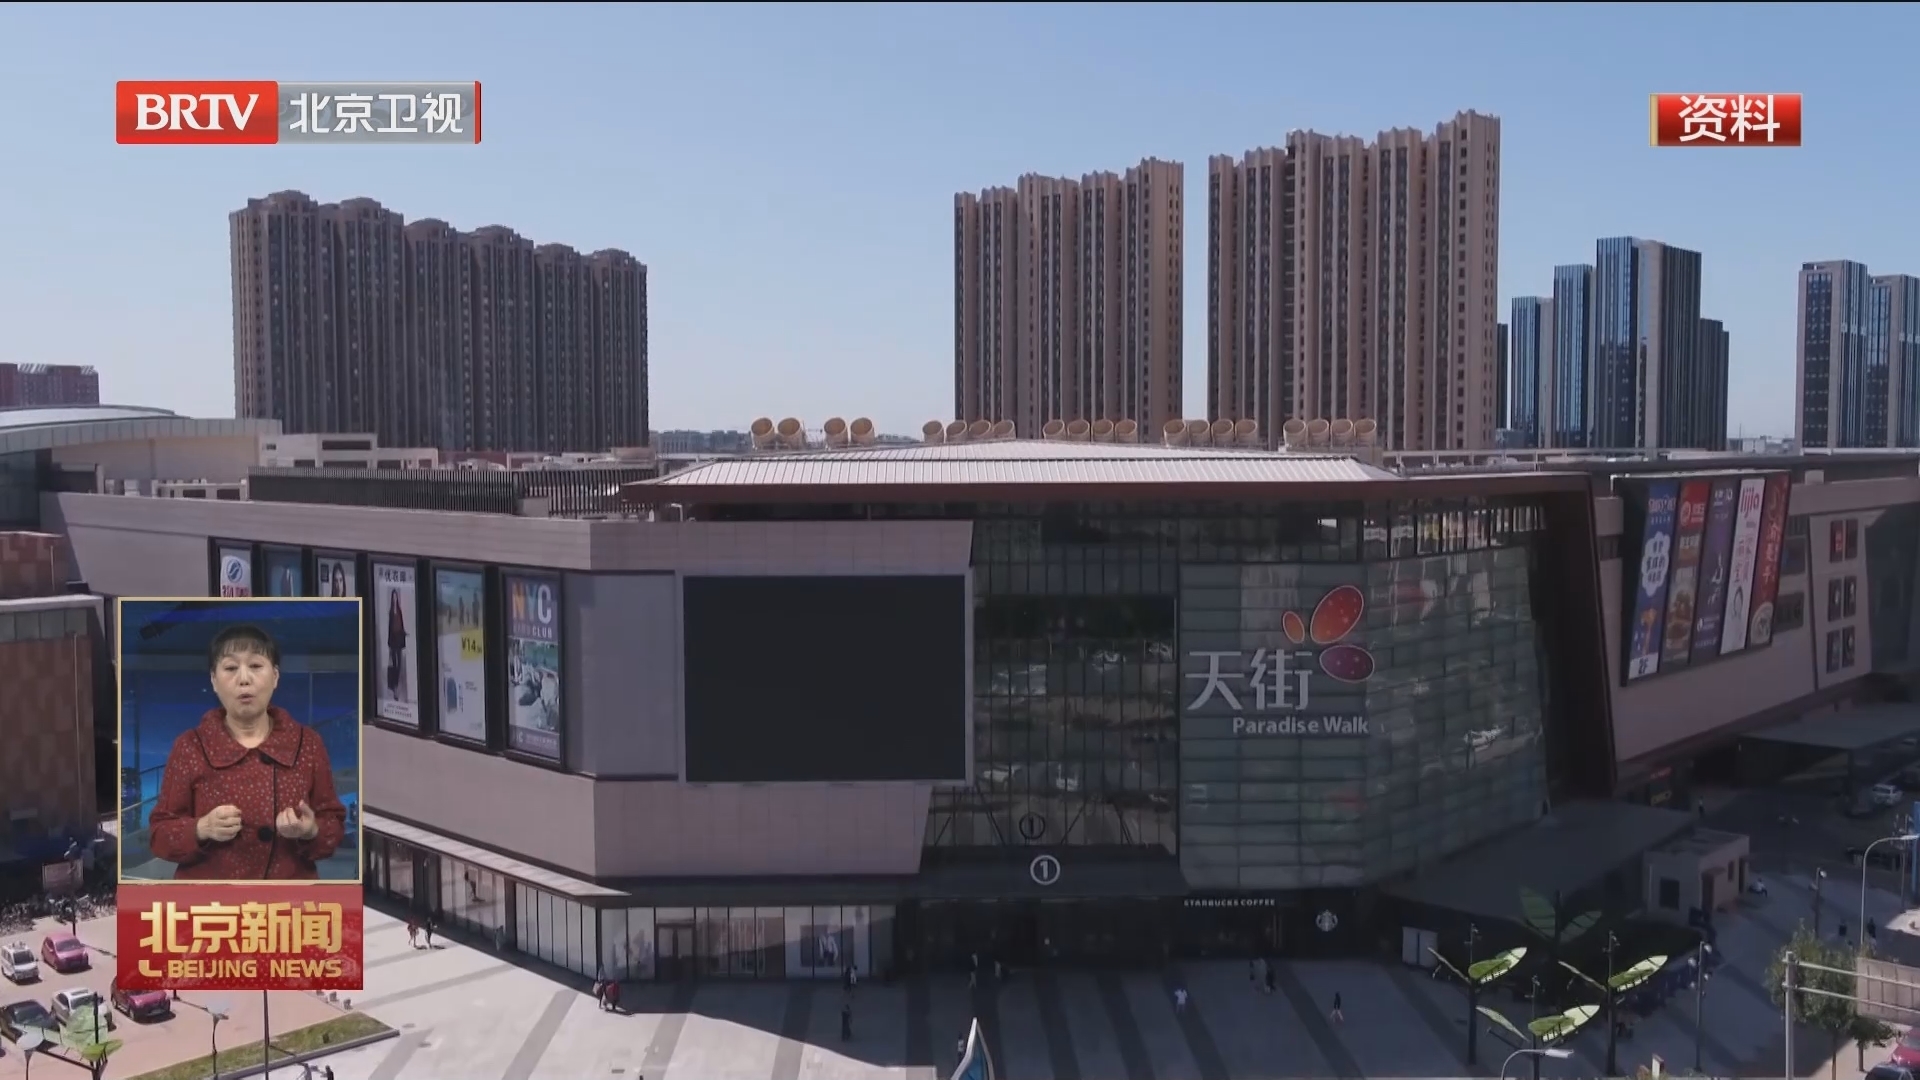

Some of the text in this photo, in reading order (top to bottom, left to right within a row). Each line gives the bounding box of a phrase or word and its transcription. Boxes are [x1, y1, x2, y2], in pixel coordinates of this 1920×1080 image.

[1184, 647, 1313, 711] 天街
[1232, 716, 1369, 734] Paradise Walk
[1183, 898, 1275, 907] STARBUCKS COFFEE
